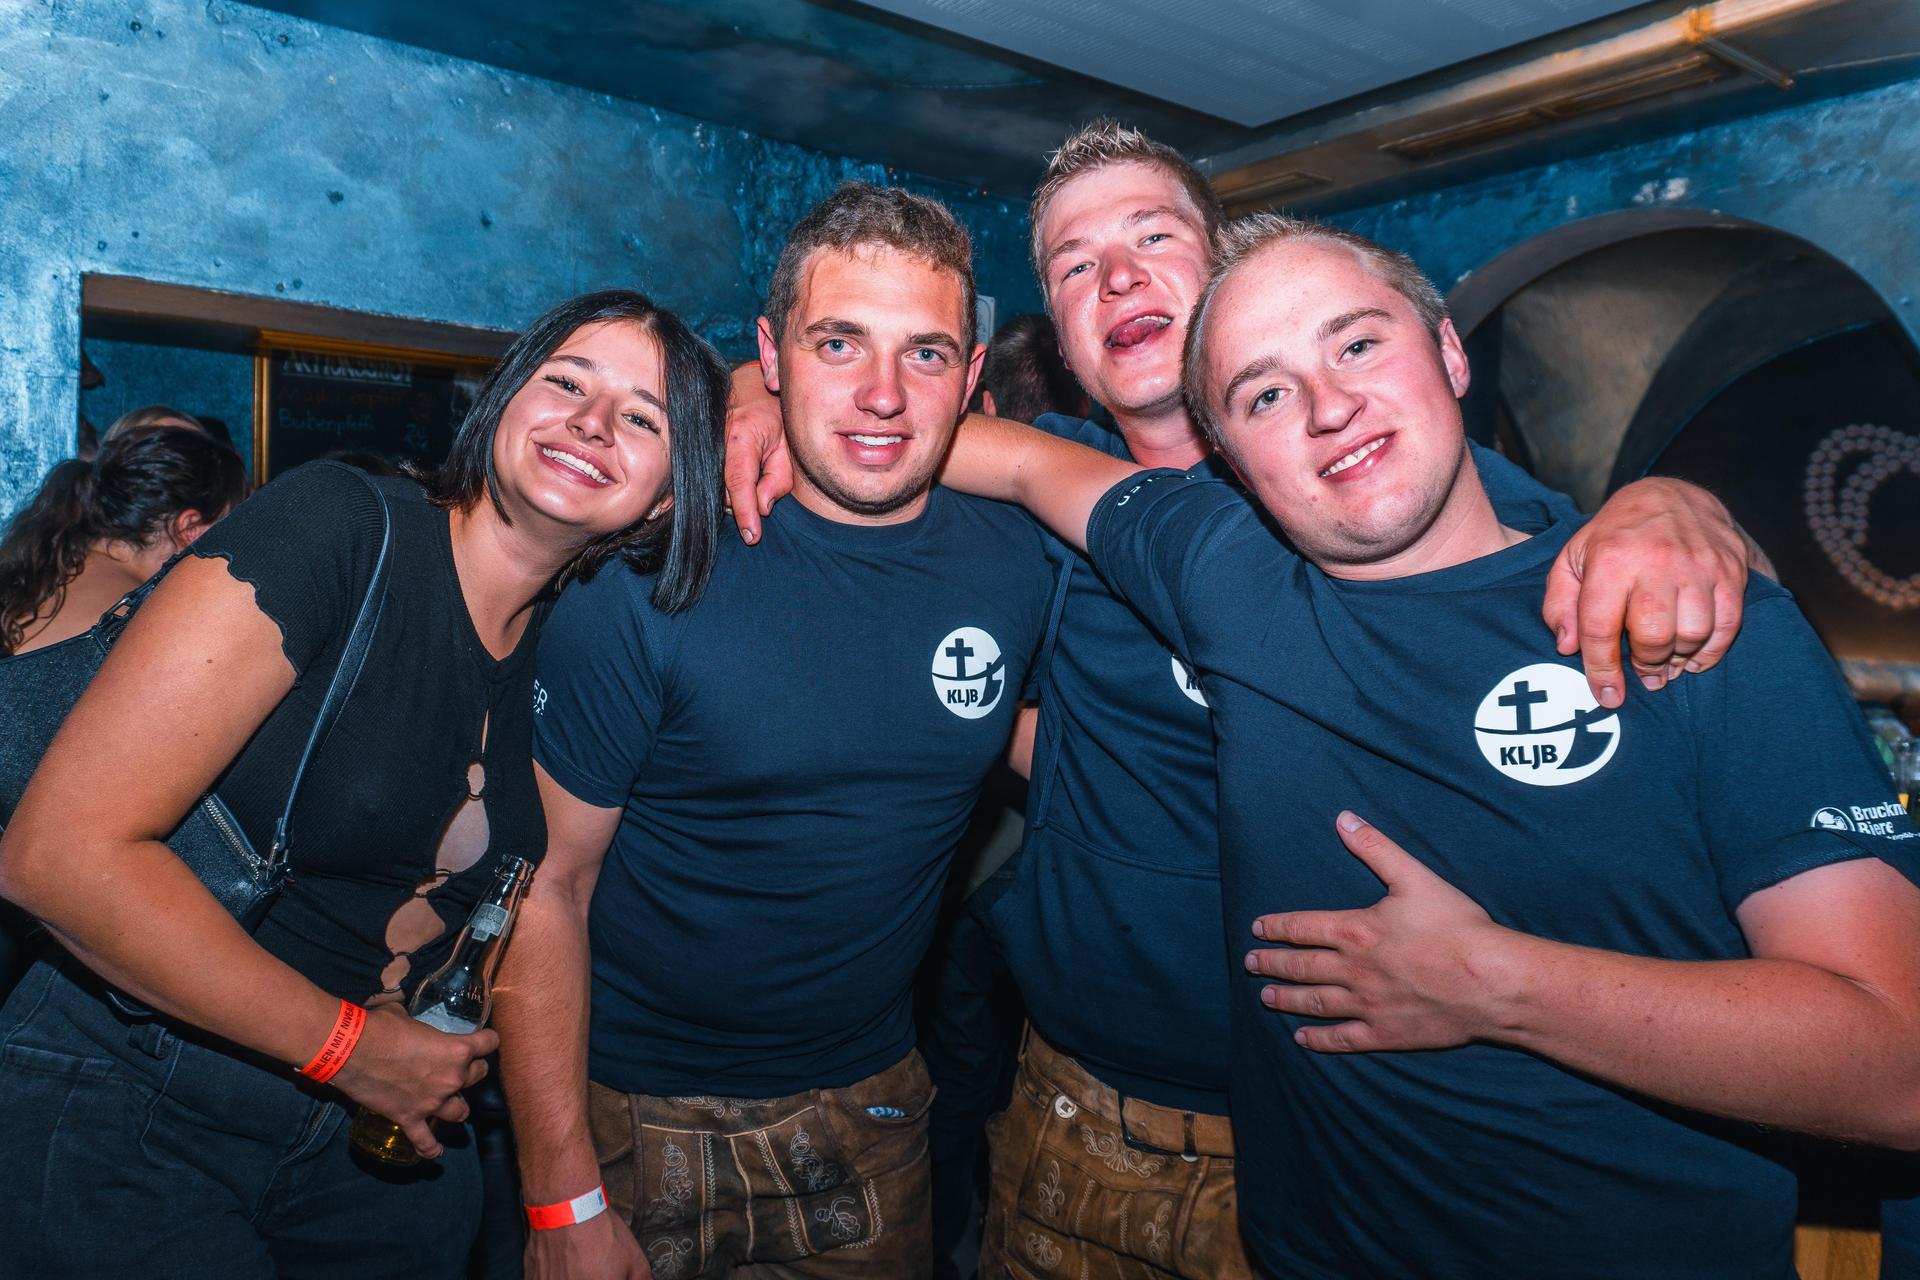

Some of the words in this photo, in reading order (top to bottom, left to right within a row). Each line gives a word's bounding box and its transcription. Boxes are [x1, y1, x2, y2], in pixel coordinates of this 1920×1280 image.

[947, 689, 978, 707] KLJB
[1500, 744, 1558, 770] KLJB
[330, 1029, 346, 1049] MIT
